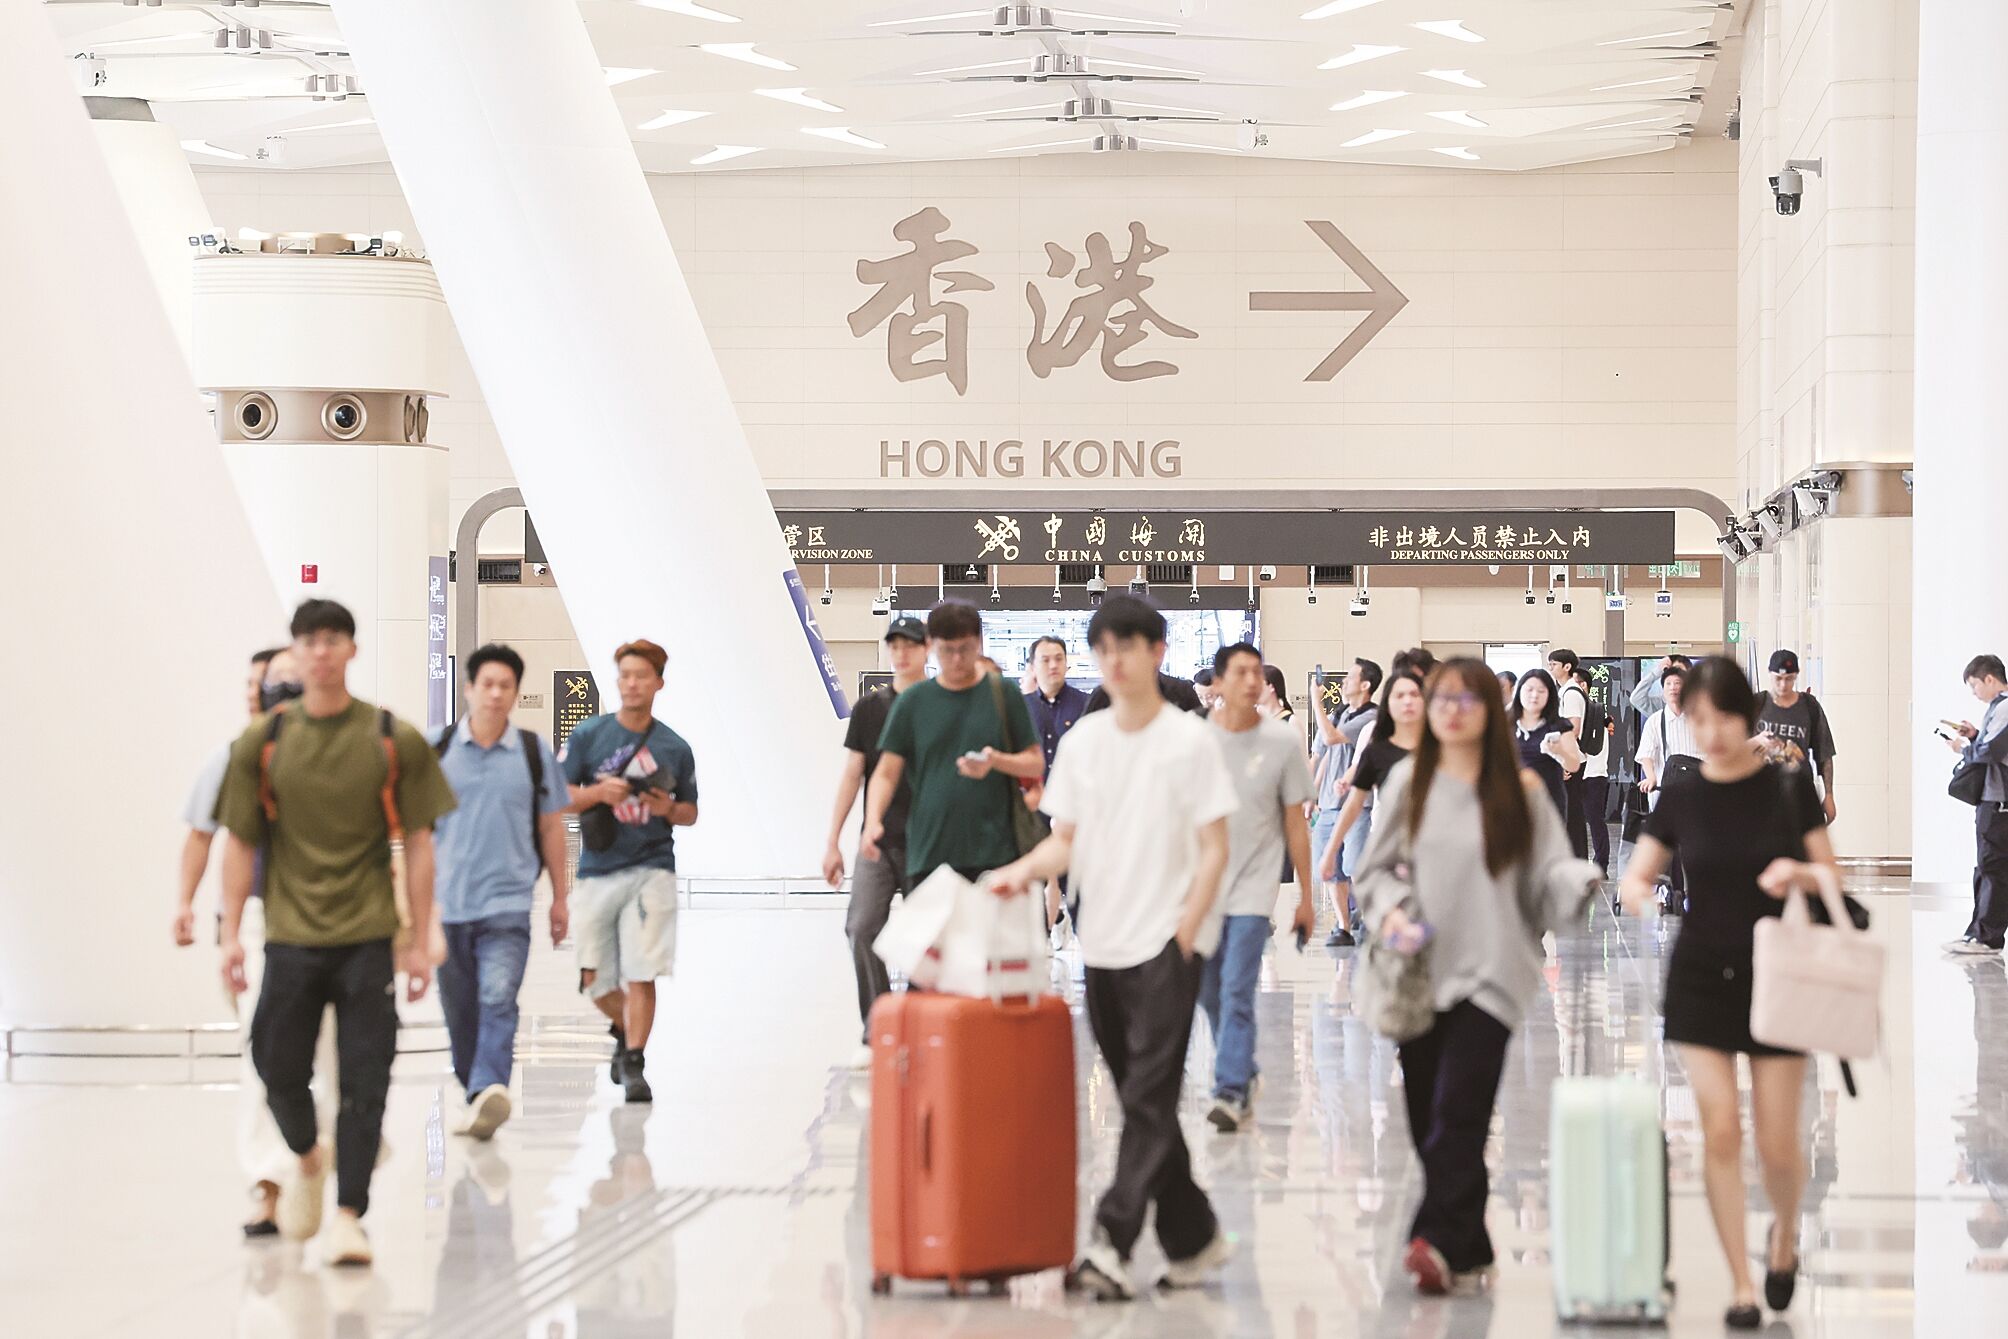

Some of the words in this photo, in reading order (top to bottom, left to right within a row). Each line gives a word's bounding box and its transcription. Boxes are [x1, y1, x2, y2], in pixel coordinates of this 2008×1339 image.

[847, 207, 1199, 396] 香港
[879, 439, 1025, 478] HONG
[1042, 439, 1182, 478] KONG
[1368, 525, 1591, 549] 非出境人员禁止入内
[841, 549, 873, 559] ZONE
[1044, 550, 1103, 562] CHINA
[1118, 550, 1206, 562] CUSTOMS
[1390, 550, 1458, 560] DEPARTING
[1460, 550, 1535, 560] PASSENGERS
[1536, 550, 1570, 560] ONLY
[1756, 720, 1807, 739] QUEEN
